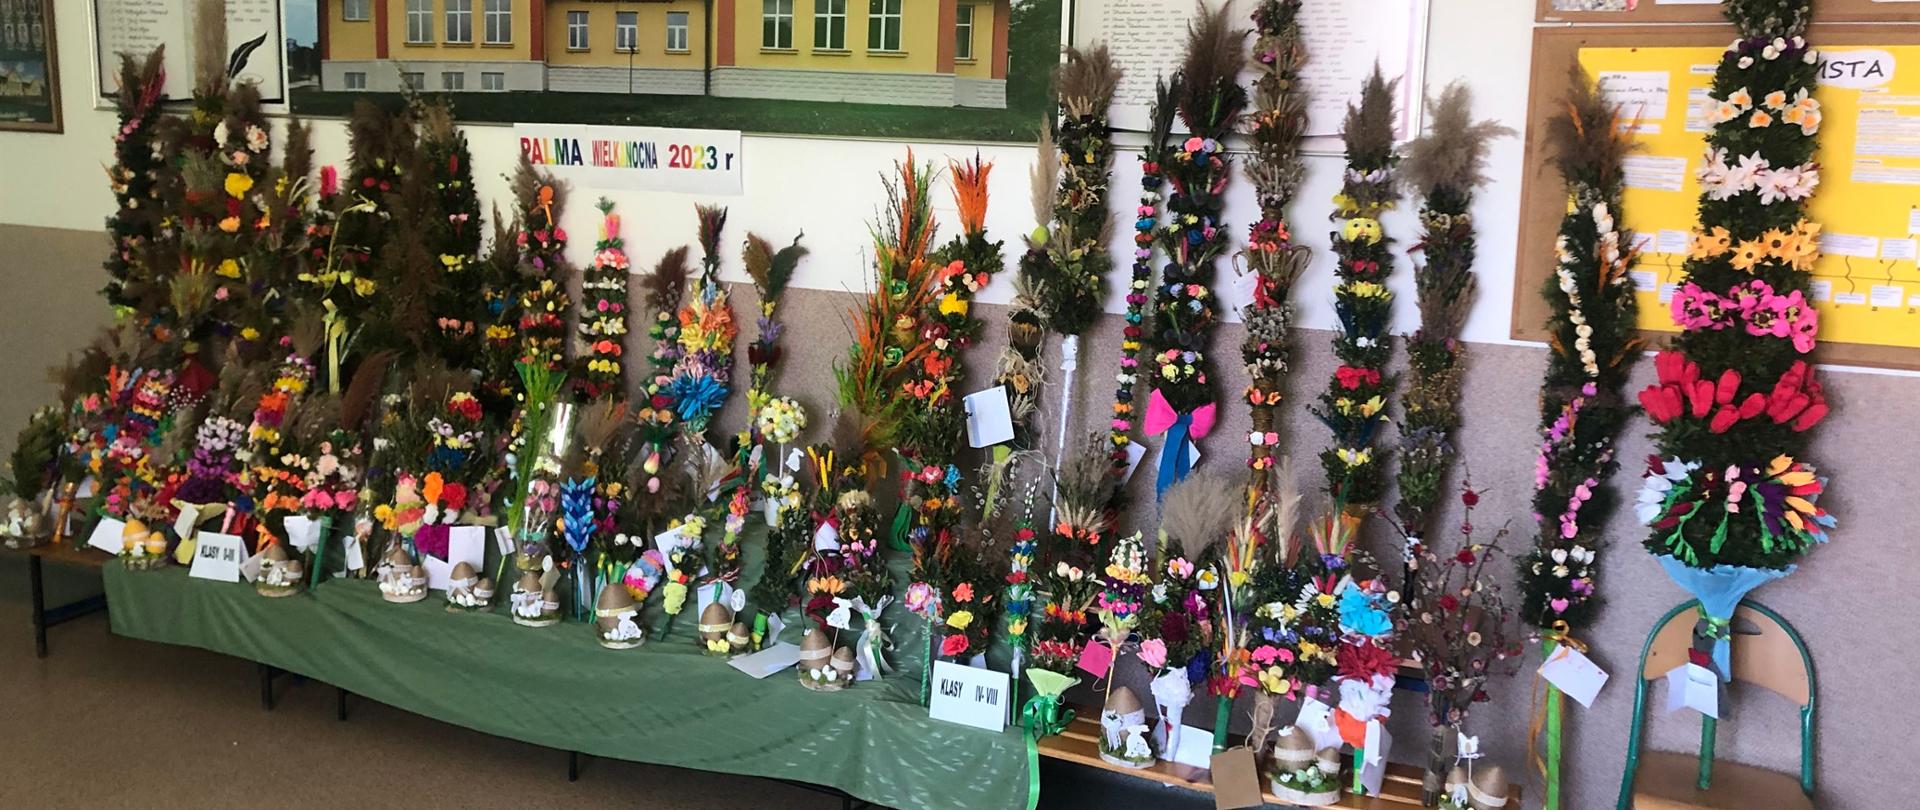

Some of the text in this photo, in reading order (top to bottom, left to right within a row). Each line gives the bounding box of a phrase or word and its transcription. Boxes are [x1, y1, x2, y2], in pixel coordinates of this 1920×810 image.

[520, 137, 734, 170] PALMA WIELKANOCNA 2023 r
[201, 544, 220, 560] KLASY
[940, 678, 963, 698] KLASY
